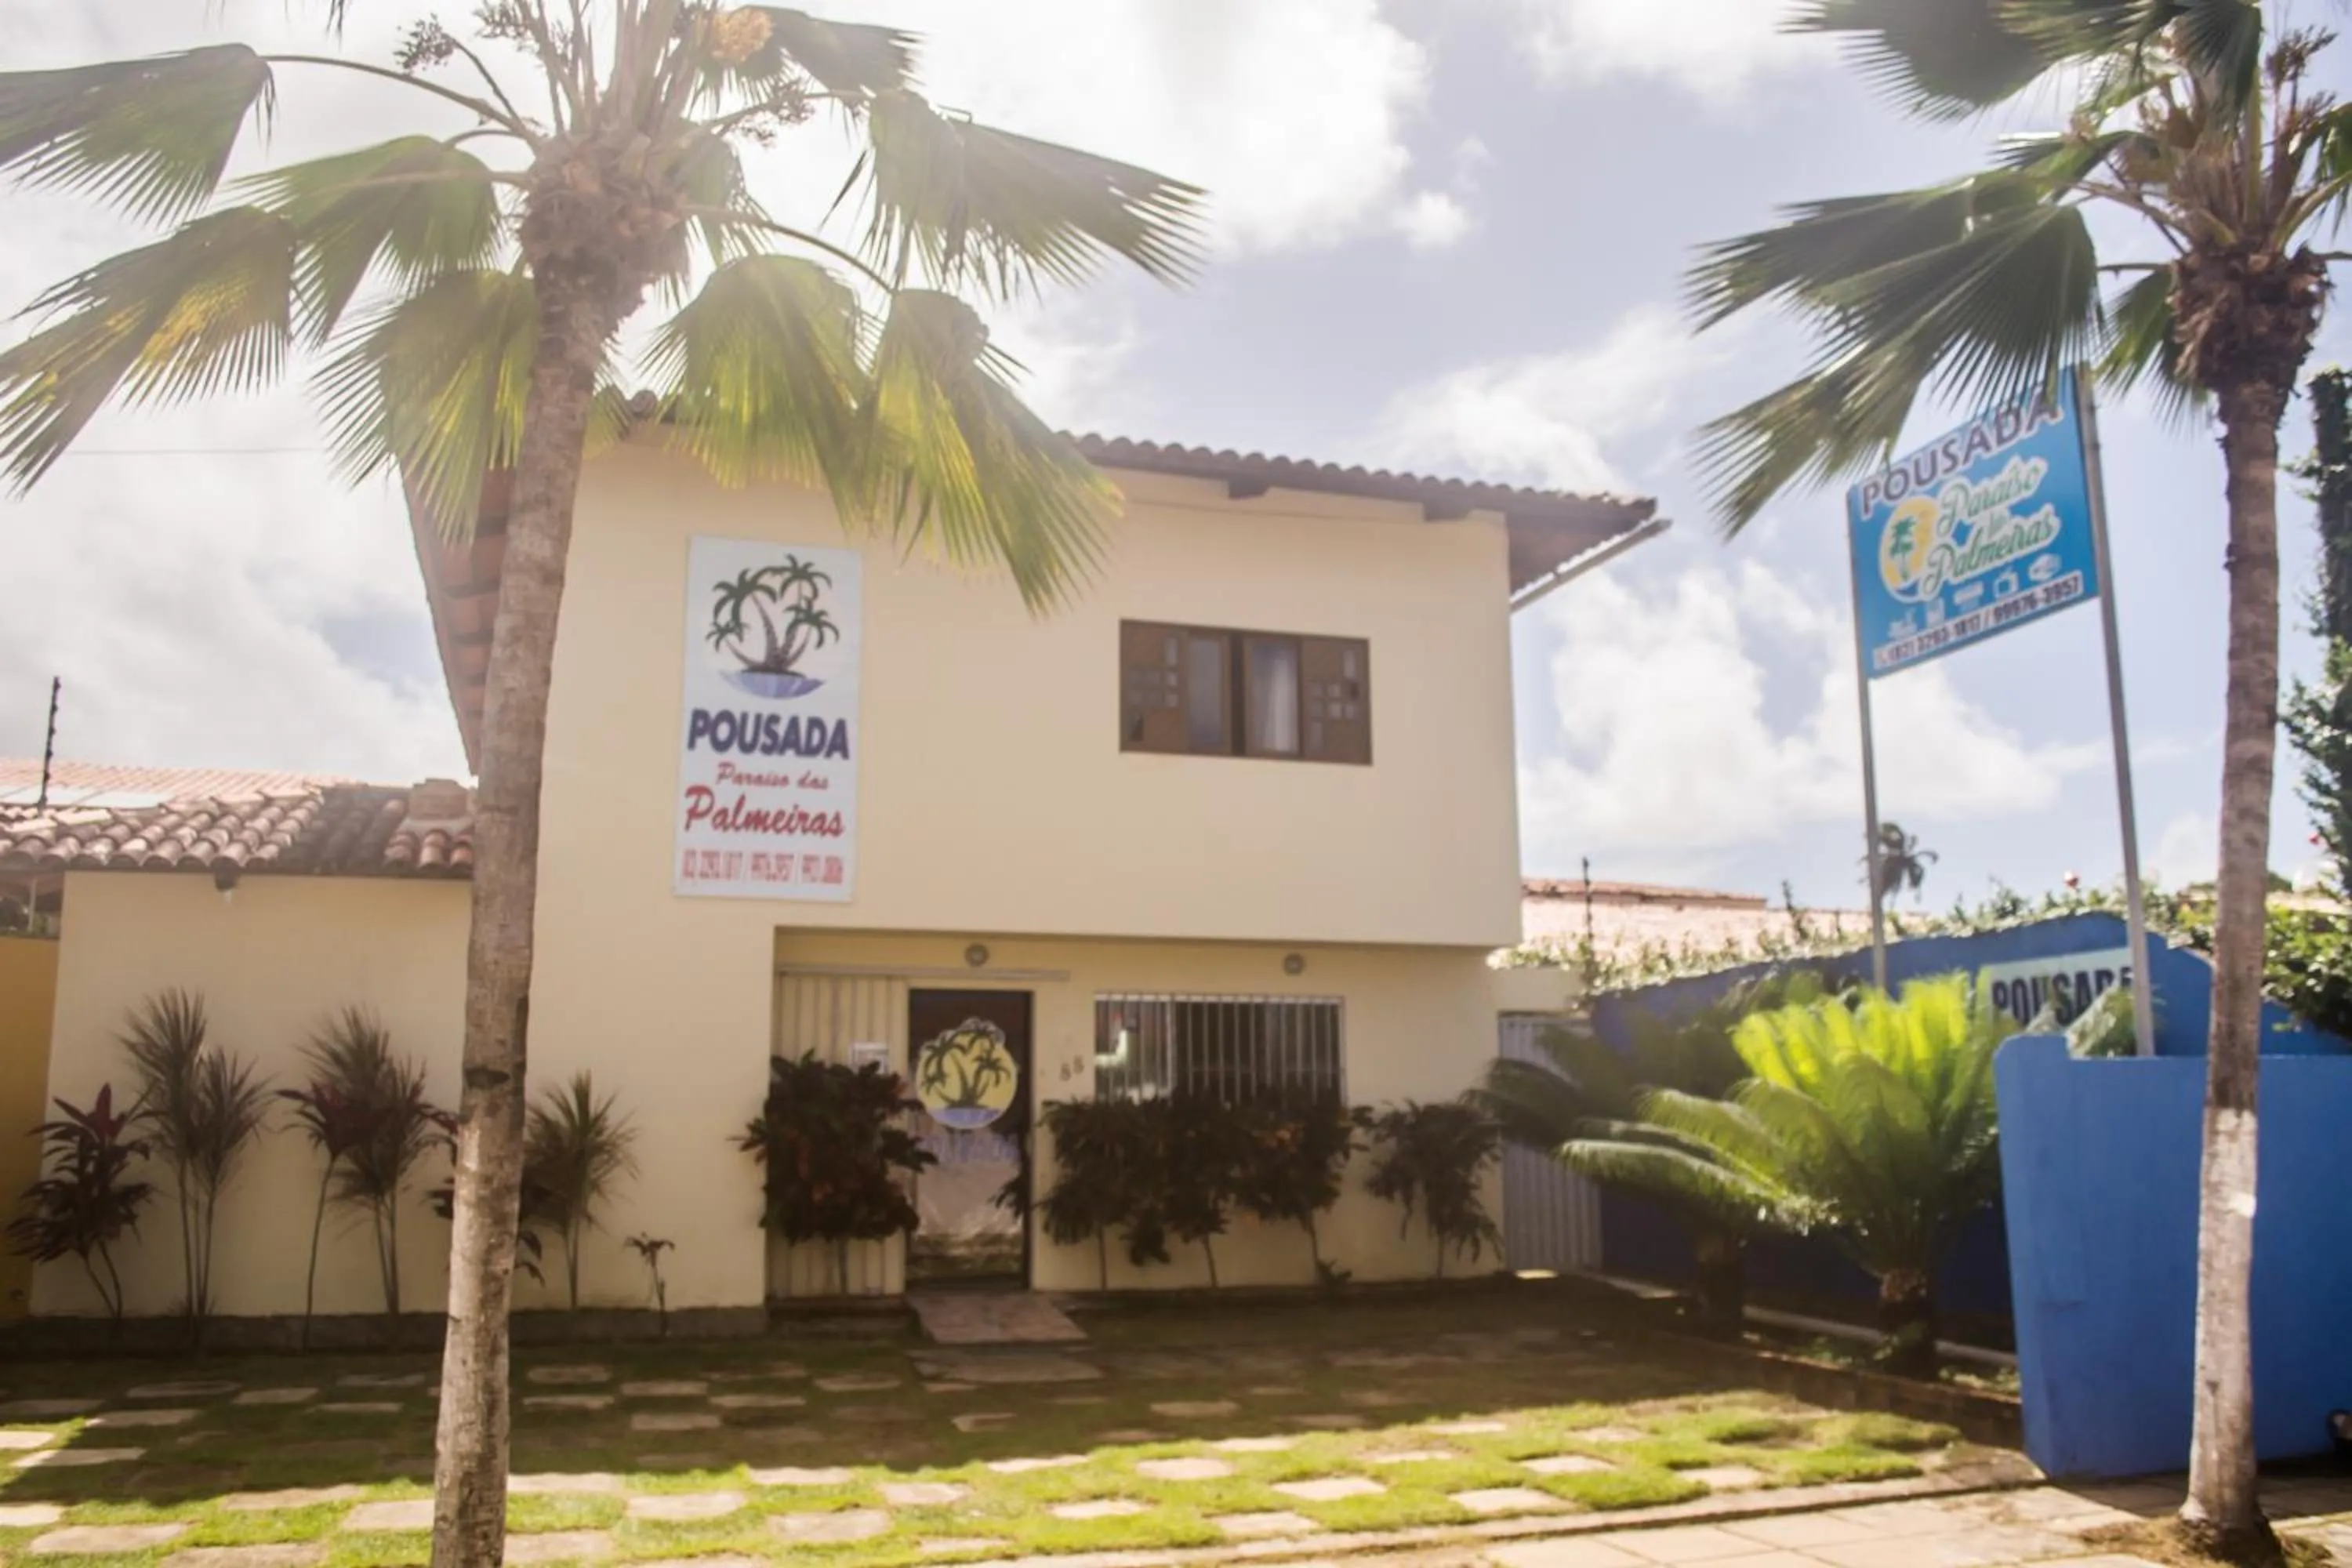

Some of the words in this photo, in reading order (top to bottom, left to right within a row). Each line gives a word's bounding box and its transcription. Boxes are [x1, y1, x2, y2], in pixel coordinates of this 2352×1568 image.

[1863, 386, 2060, 515] POUSADA
[1922, 511, 2054, 596] Palmeiras
[687, 709, 850, 760] POUSADA
[717, 761, 789, 786] Paraiso
[798, 769, 829, 790] das
[684, 785, 846, 837] Palmeiras
